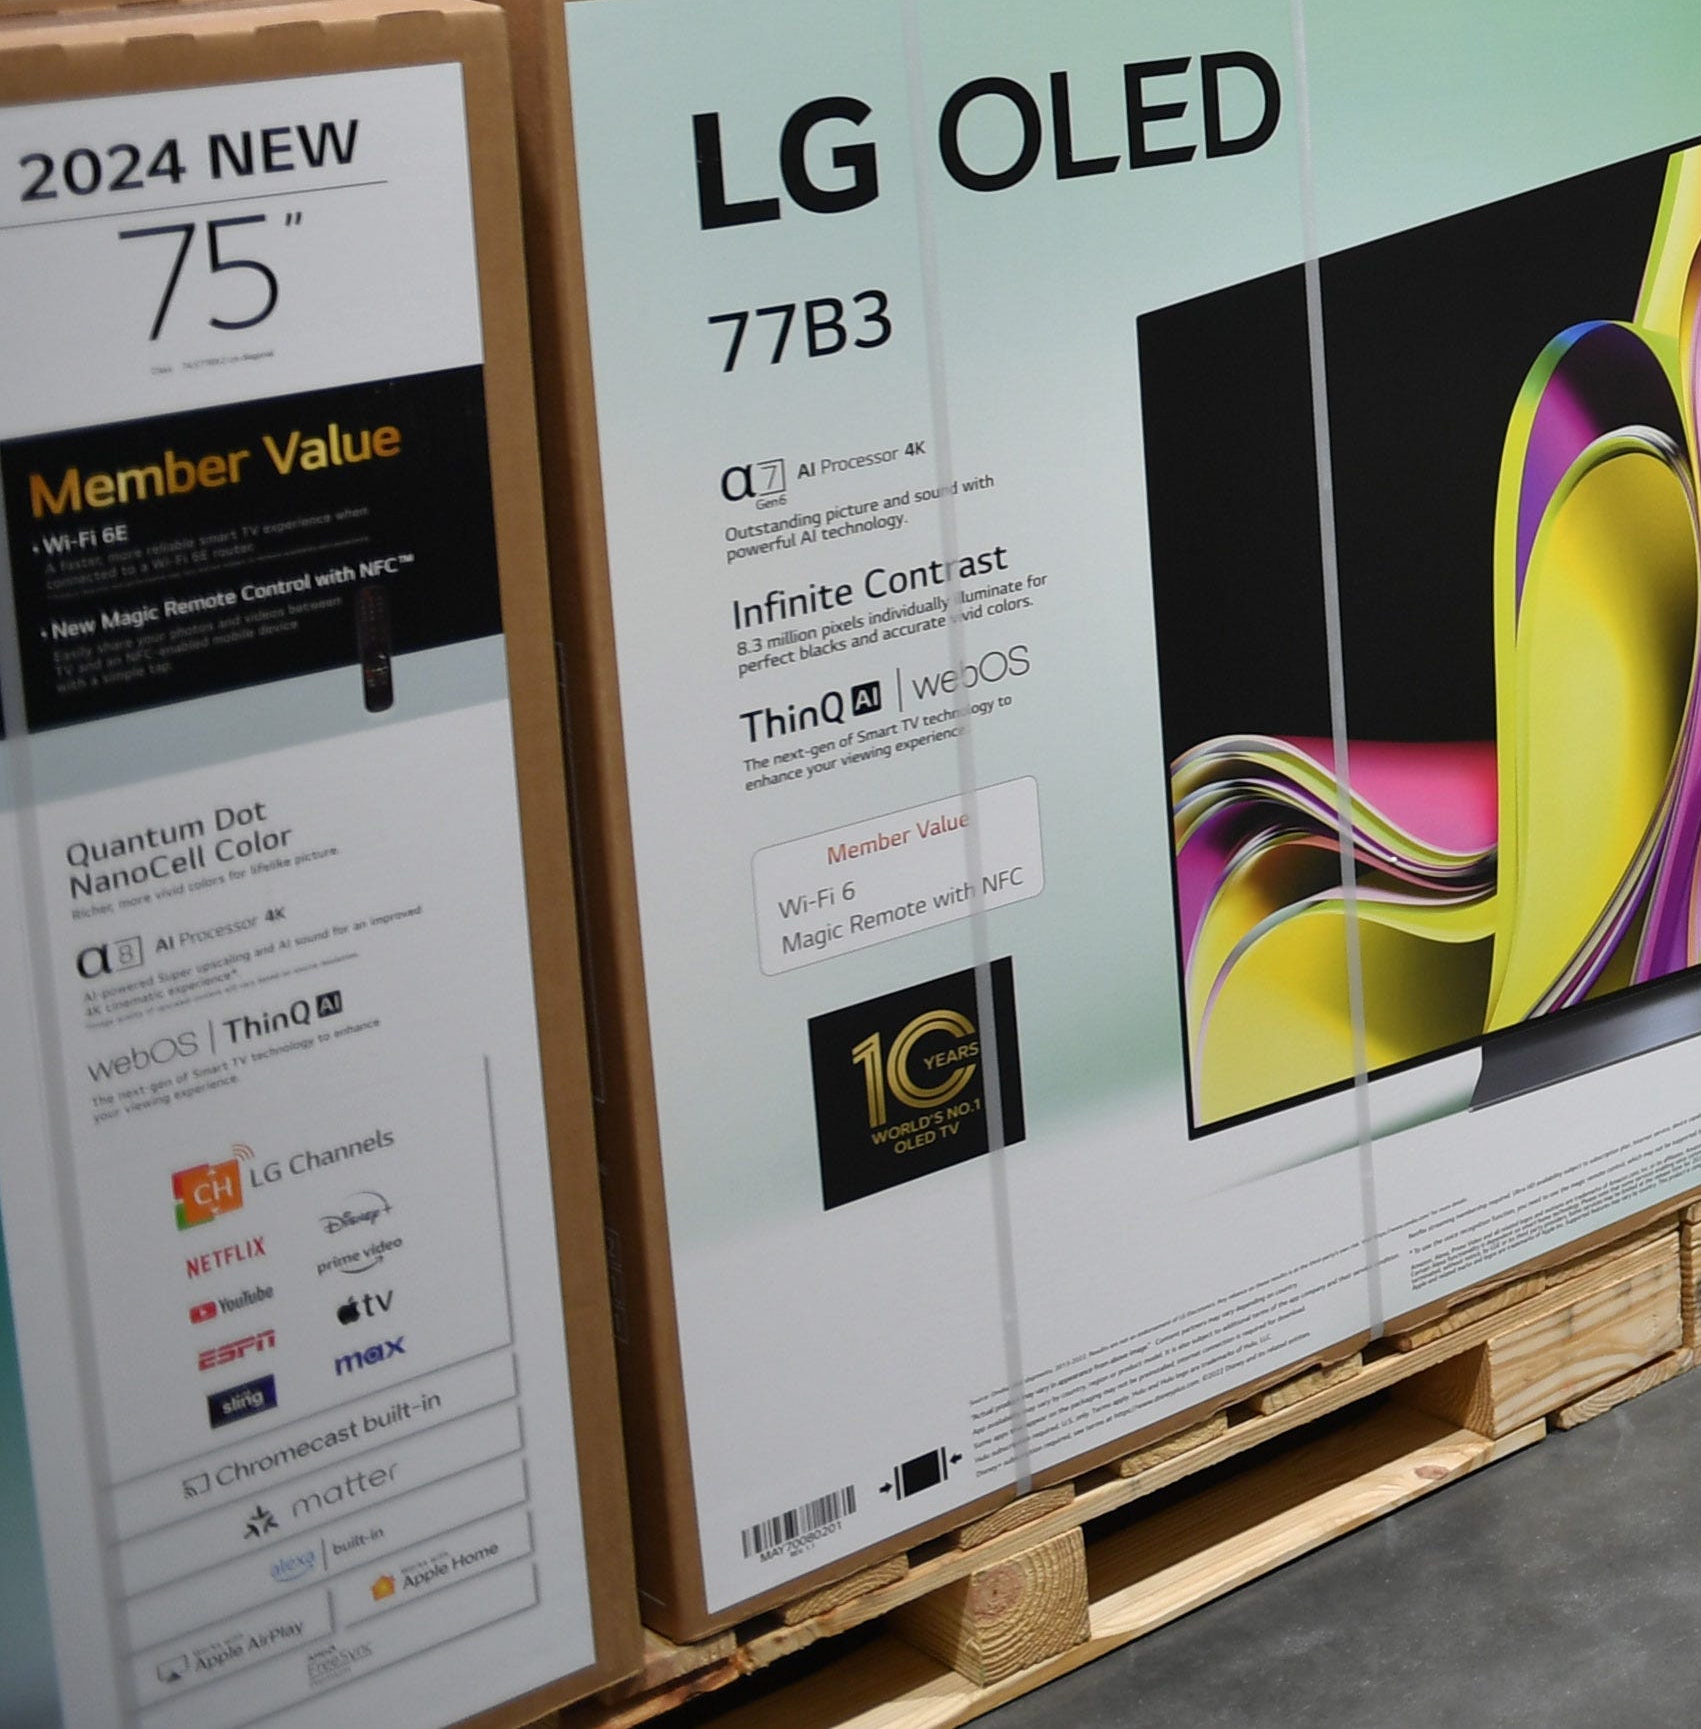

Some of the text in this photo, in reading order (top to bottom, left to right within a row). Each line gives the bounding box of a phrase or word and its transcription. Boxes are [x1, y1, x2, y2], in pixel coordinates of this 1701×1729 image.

[20, 119, 360, 202] 2024 NEW
[692, 50, 1281, 231] LG OLED
[117, 212, 304, 342] 75"
[707, 289, 892, 373] 77B3
[29, 420, 402, 518] Member Value
[797, 441, 926, 481] AI Processor 4K
[42, 522, 128, 555] Wi-Fi 6E
[52, 615, 95, 641] New
[99, 602, 161, 633] Magic
[164, 586, 236, 617] Remote
[240, 573, 312, 603] Control
[315, 565, 356, 592] with
[732, 545, 1008, 630] Infinite Contrast
[740, 645, 1030, 744] ThinQ webOS
[66, 800, 268, 869] Quantum Dot
[827, 812, 970, 865] Member Value
[69, 824, 292, 901] NanoCell Color
[778, 881, 856, 919] Wi-Fi 6
[781, 866, 1025, 955] Magic Remote with NFC
[155, 906, 287, 956] AI Processor 4K
[87, 999, 312, 1082] webOS ThinQ
[924, 1042, 980, 1071] YEARS
[871, 1098, 982, 1145] WORLD'S NO.1
[894, 1121, 960, 1154] OLED TV
[192, 1127, 396, 1208] CH LG Channels
[186, 1237, 268, 1279] NETFLIX
[317, 1238, 404, 1277] prime video
[218, 1284, 274, 1316] YouTube
[362, 1288, 394, 1318] tv
[198, 1330, 277, 1371] ESPN
[335, 1335, 407, 1376] max
[221, 1387, 265, 1415] sling
[216, 1390, 443, 1488] Chromecast built-in
[292, 1463, 401, 1519] matter
[402, 1541, 500, 1590] Apple Home
[193, 1620, 304, 1674] Apple AirPlay
